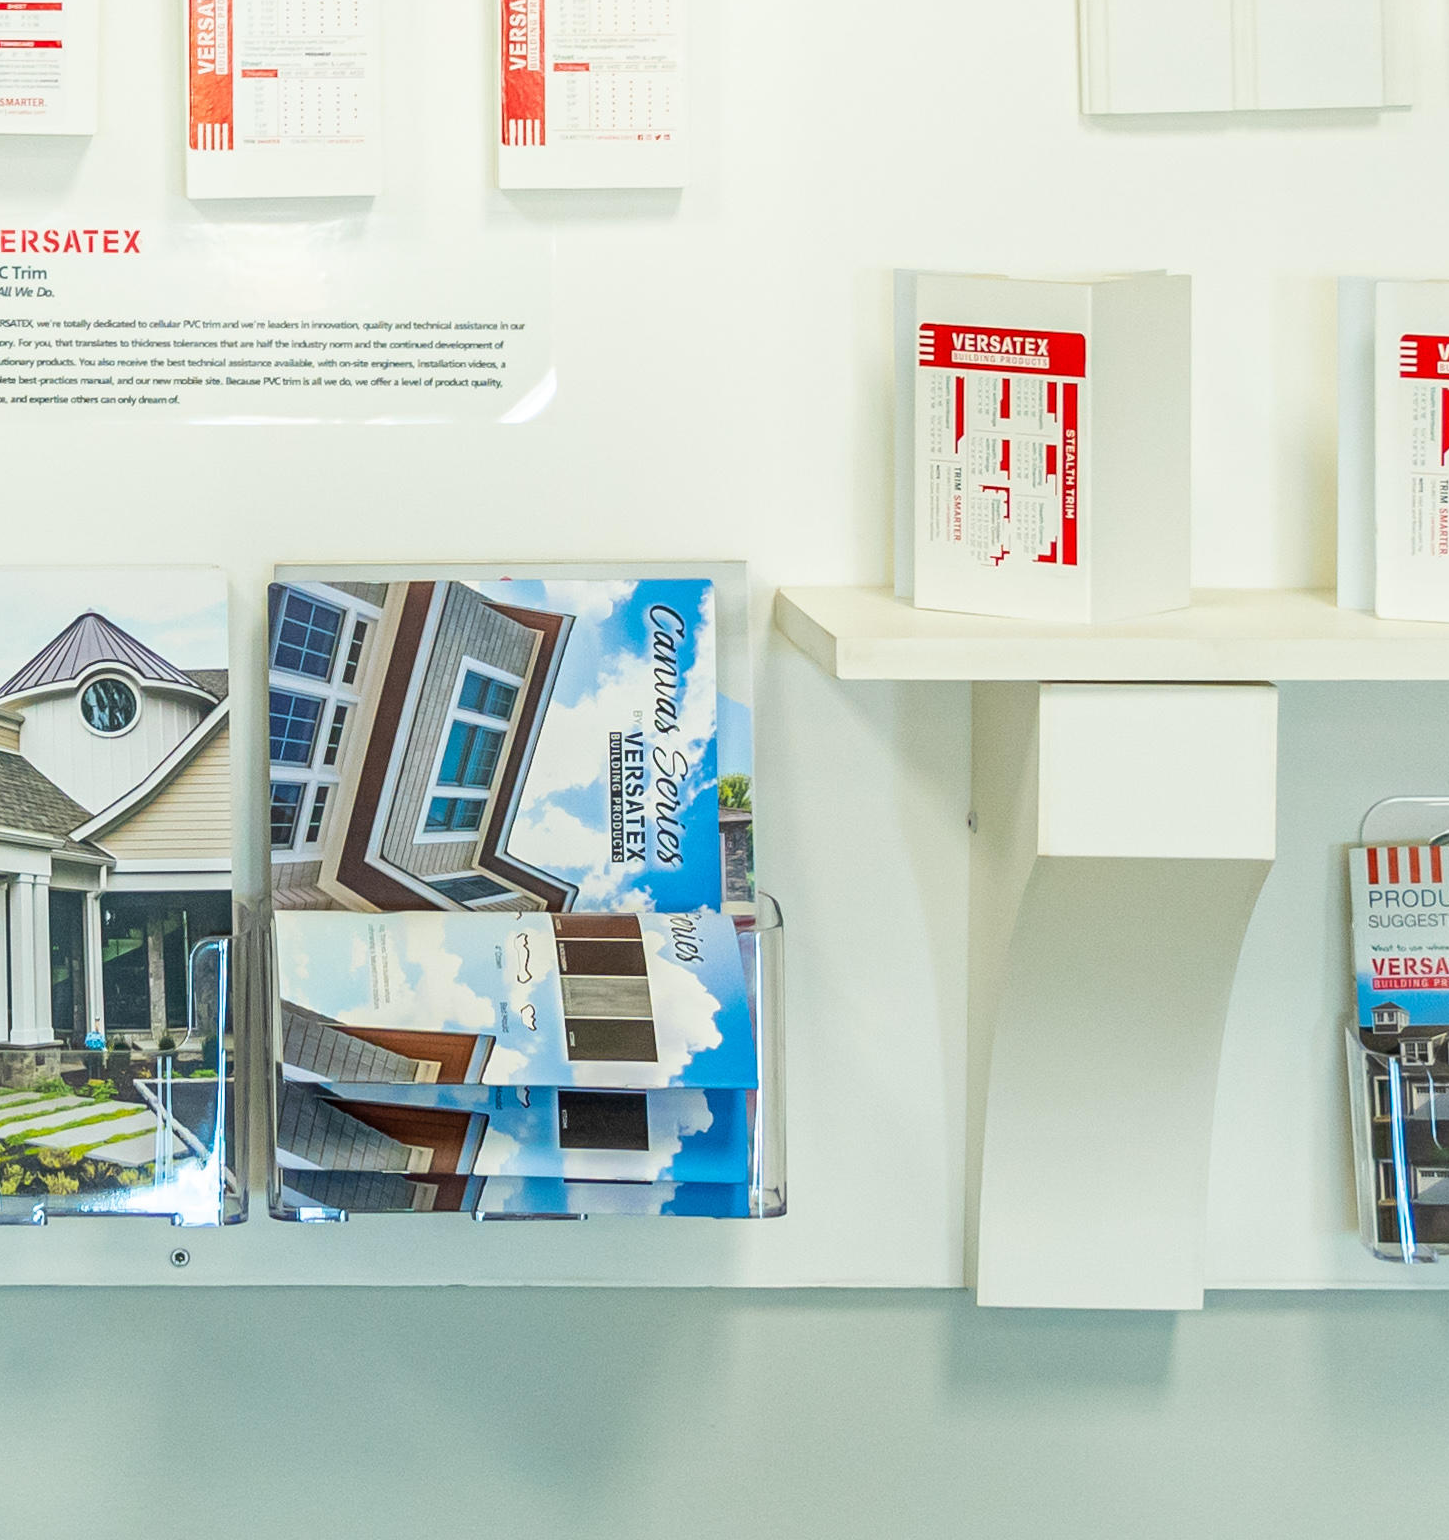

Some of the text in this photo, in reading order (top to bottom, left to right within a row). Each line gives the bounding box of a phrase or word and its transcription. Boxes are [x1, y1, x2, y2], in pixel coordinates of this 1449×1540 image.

[12, 266, 47, 280] Trim
[15, 286, 33, 298] We
[37, 286, 55, 298] Do.
[952, 332, 1049, 356] VERSATEX
[954, 353, 1047, 367] BUILDING PRODUCTS
[953, 467, 963, 491] TRIM
[1065, 429, 1075, 519] STEALTH TRIM
[1440, 480, 1448, 504] TRIM
[649, 604, 688, 868] Canvas Series
[611, 733, 623, 862] BUILDING PRODUCTS
[624, 709, 646, 863] BY VERSATEX
[1374, 979, 1429, 988] BUILDING
